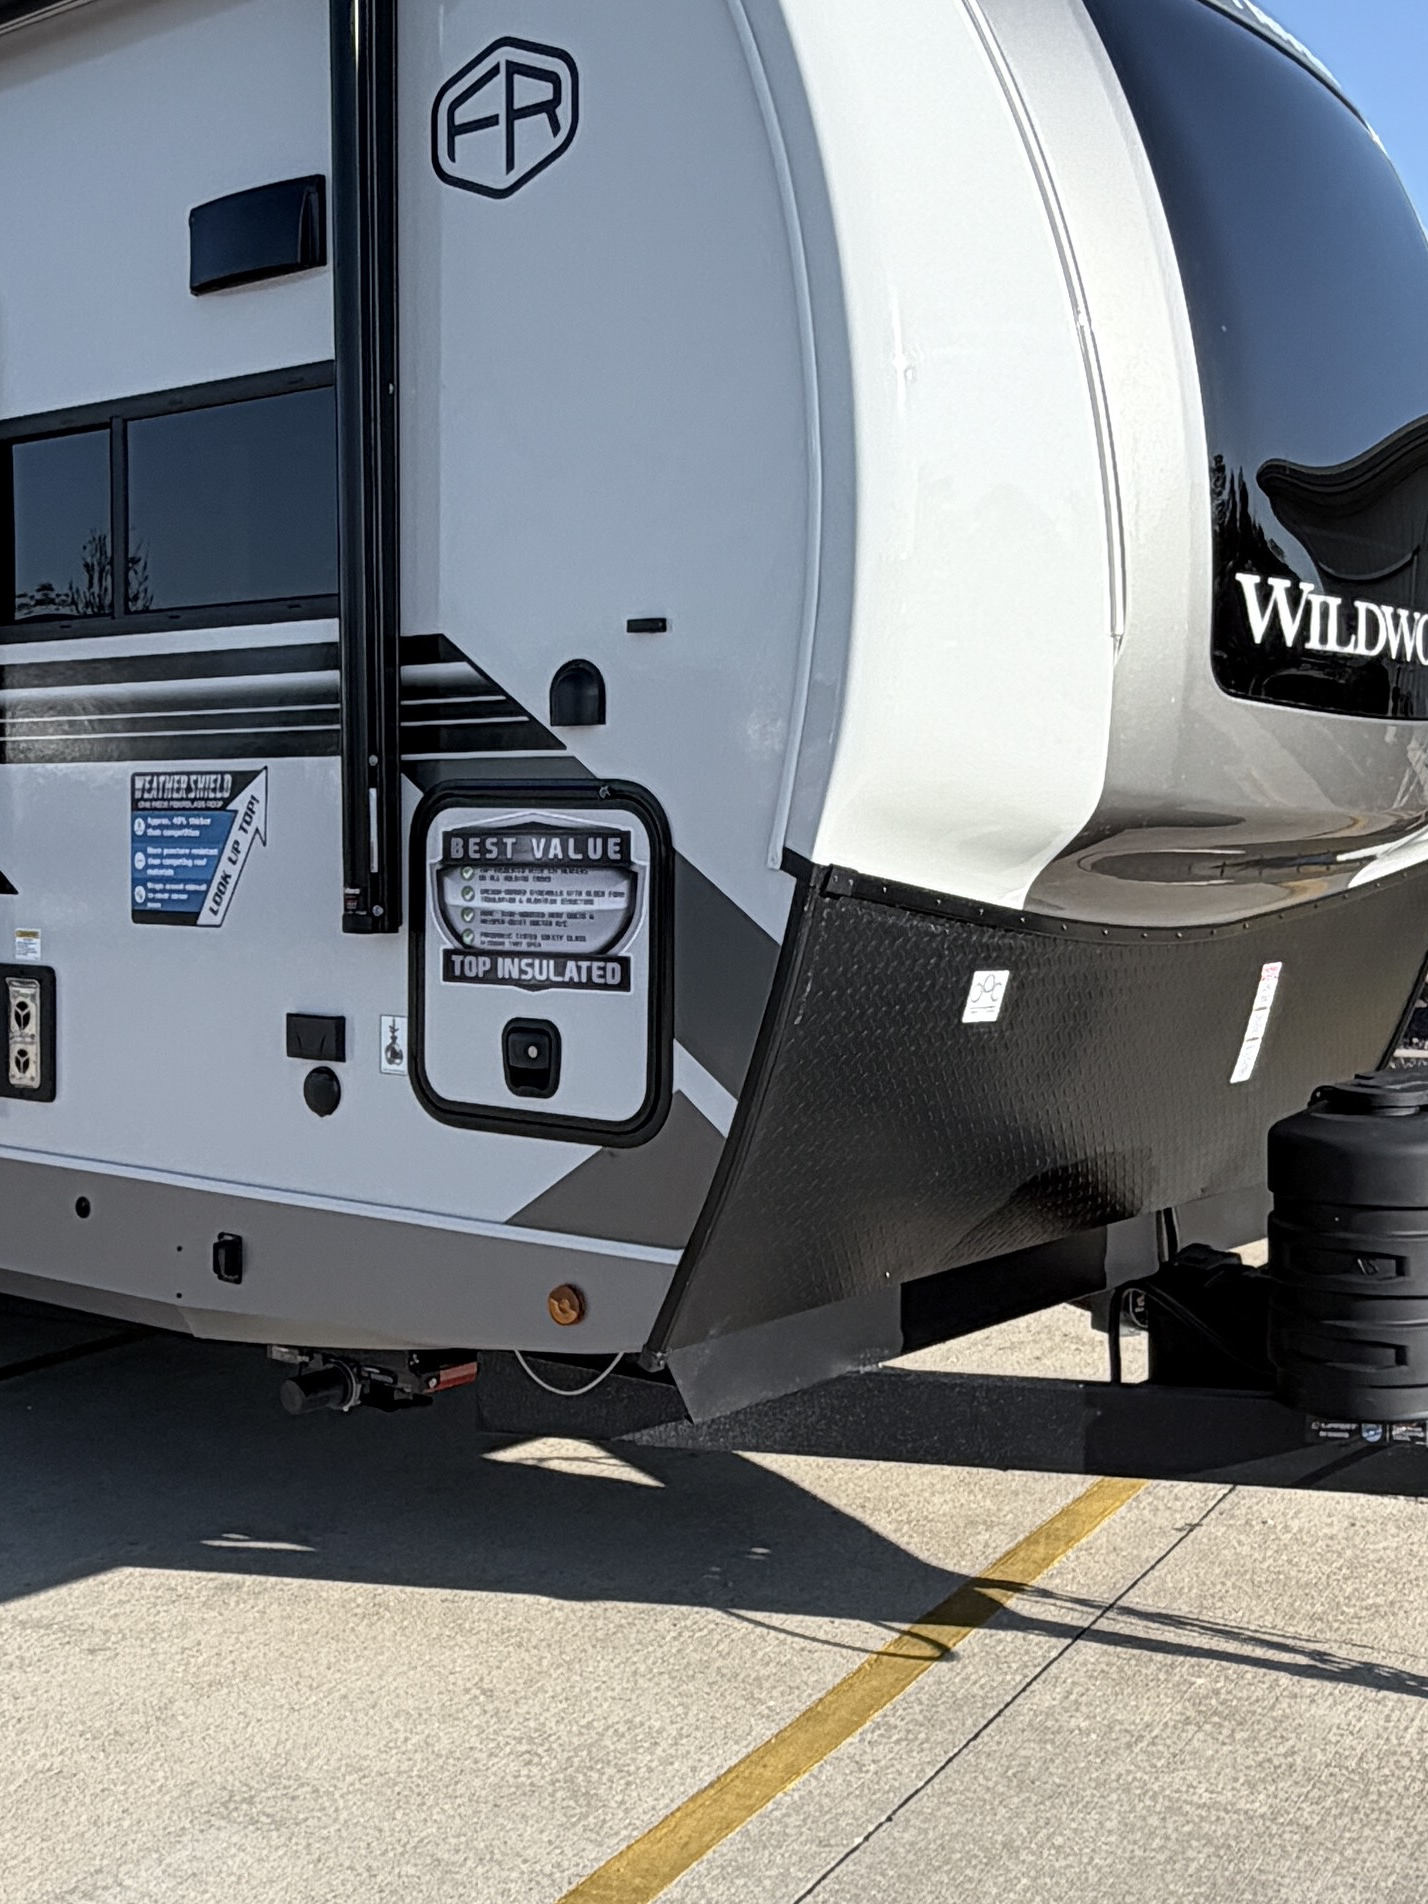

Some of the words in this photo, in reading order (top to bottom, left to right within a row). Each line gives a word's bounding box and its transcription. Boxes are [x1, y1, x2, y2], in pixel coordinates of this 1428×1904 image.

[208, 869, 232, 917] LOOK
[227, 839, 241, 866] UP
[238, 794, 260, 835] TOP!
[450, 836, 517, 860] BEST
[531, 836, 622, 861] VALUE
[451, 954, 492, 978] TOP
[496, 956, 622, 985] INSULATED
